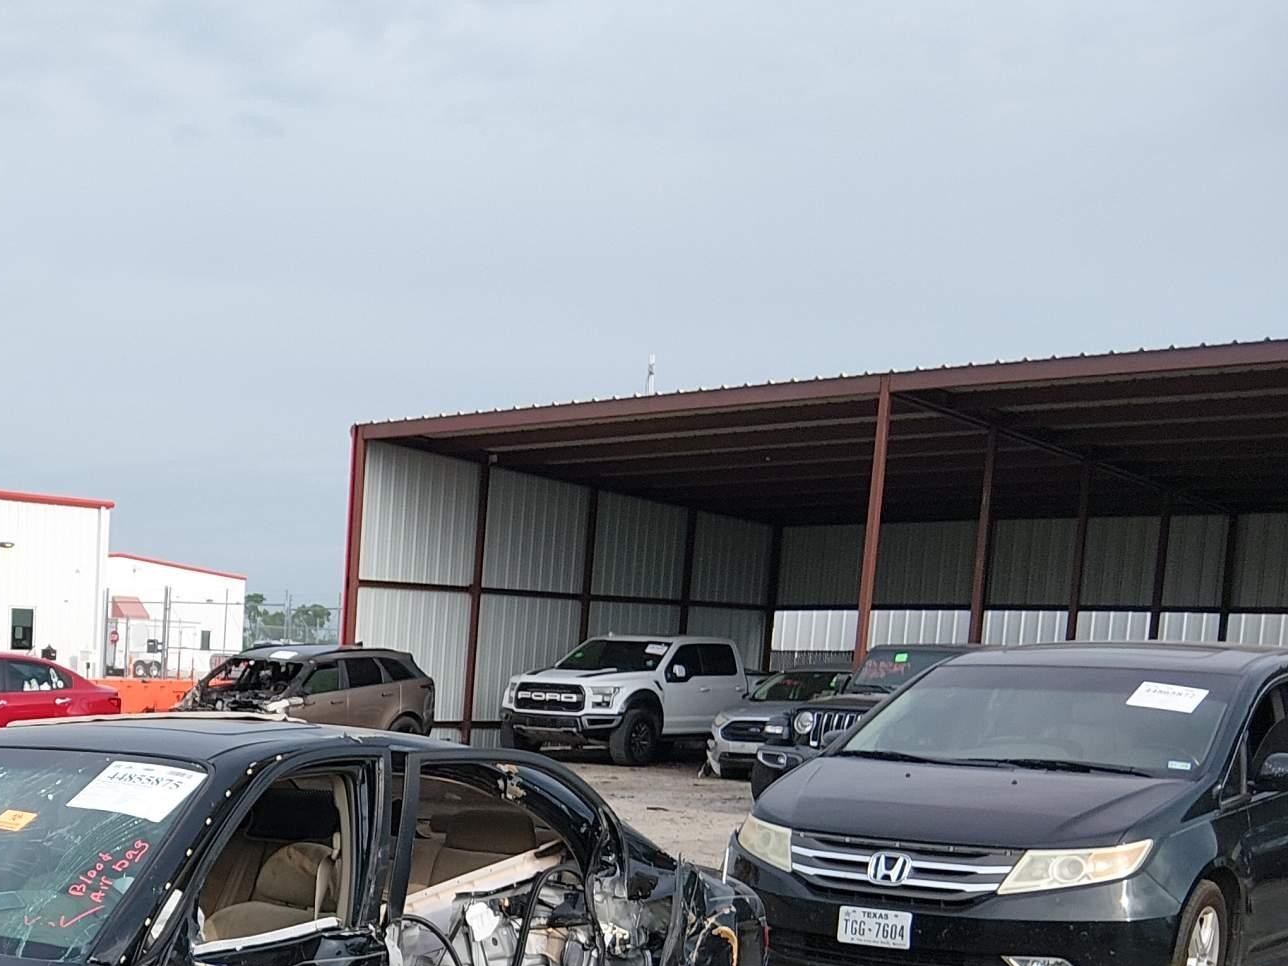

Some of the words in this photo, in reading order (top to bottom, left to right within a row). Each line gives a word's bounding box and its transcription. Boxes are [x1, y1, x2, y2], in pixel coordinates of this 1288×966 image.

[517, 691, 577, 702] FORD
[89, 875, 113, 903] Air
[112, 840, 150, 872] bag
[862, 911, 889, 920] TEXAS
